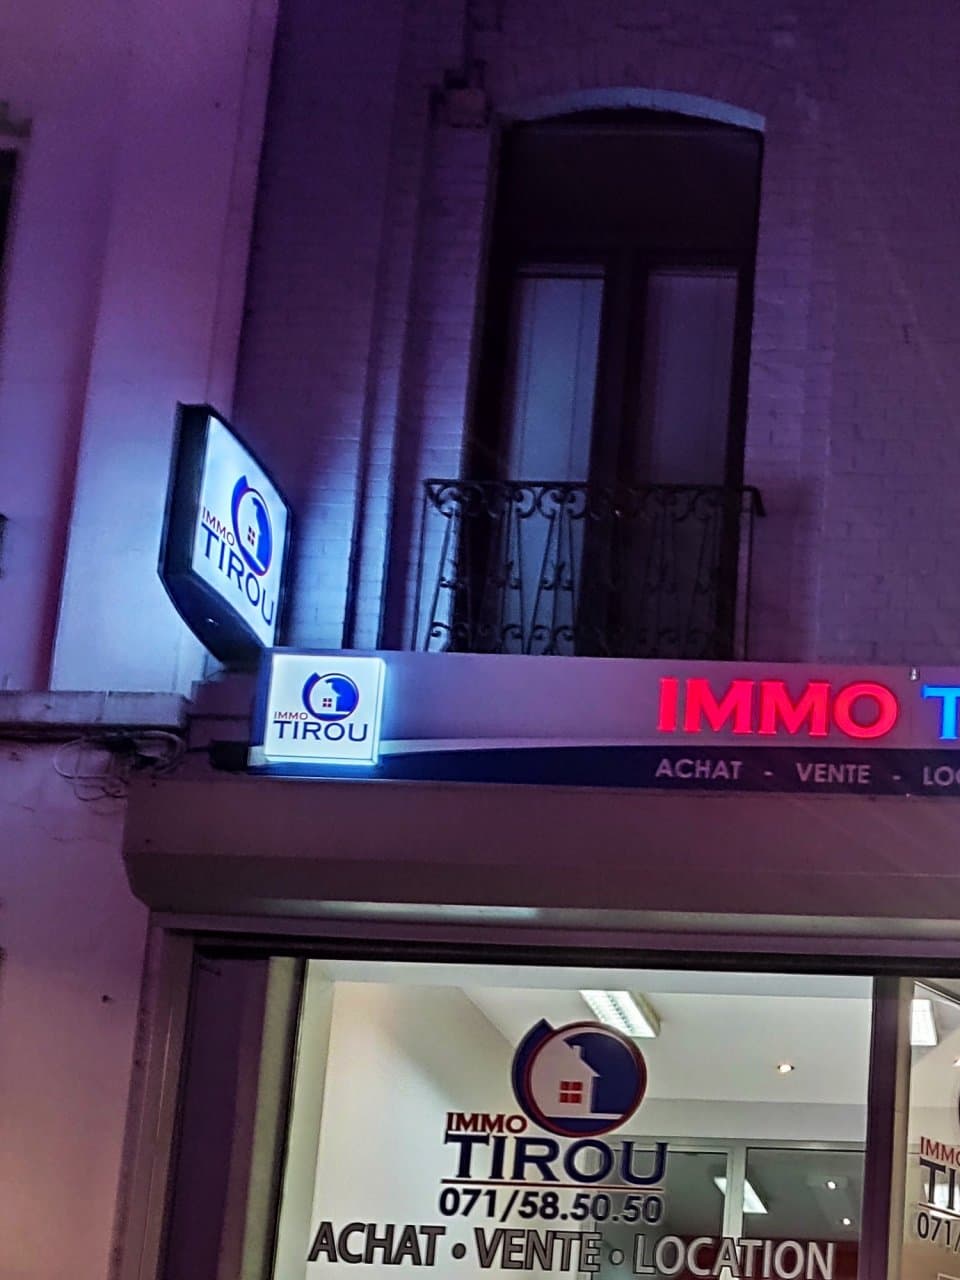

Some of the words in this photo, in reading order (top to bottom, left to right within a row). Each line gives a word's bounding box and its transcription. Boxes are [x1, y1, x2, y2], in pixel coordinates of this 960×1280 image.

[202, 506, 236, 547] IMMO
[202, 521, 275, 627] TIROU
[274, 711, 309, 721] IMMO
[656, 678, 899, 740] IMMO
[273, 720, 368, 742] TIROU
[655, 758, 743, 780] ACHAT
[797, 762, 871, 784] VENTE
[446, 1112, 528, 1135] IMMO
[443, 1132, 669, 1186] TIROU
[439, 1187, 665, 1224] 071/58.50.50
[307, 1222, 446, 1267] ACHAT
[475, 1228, 601, 1273] VENTE
